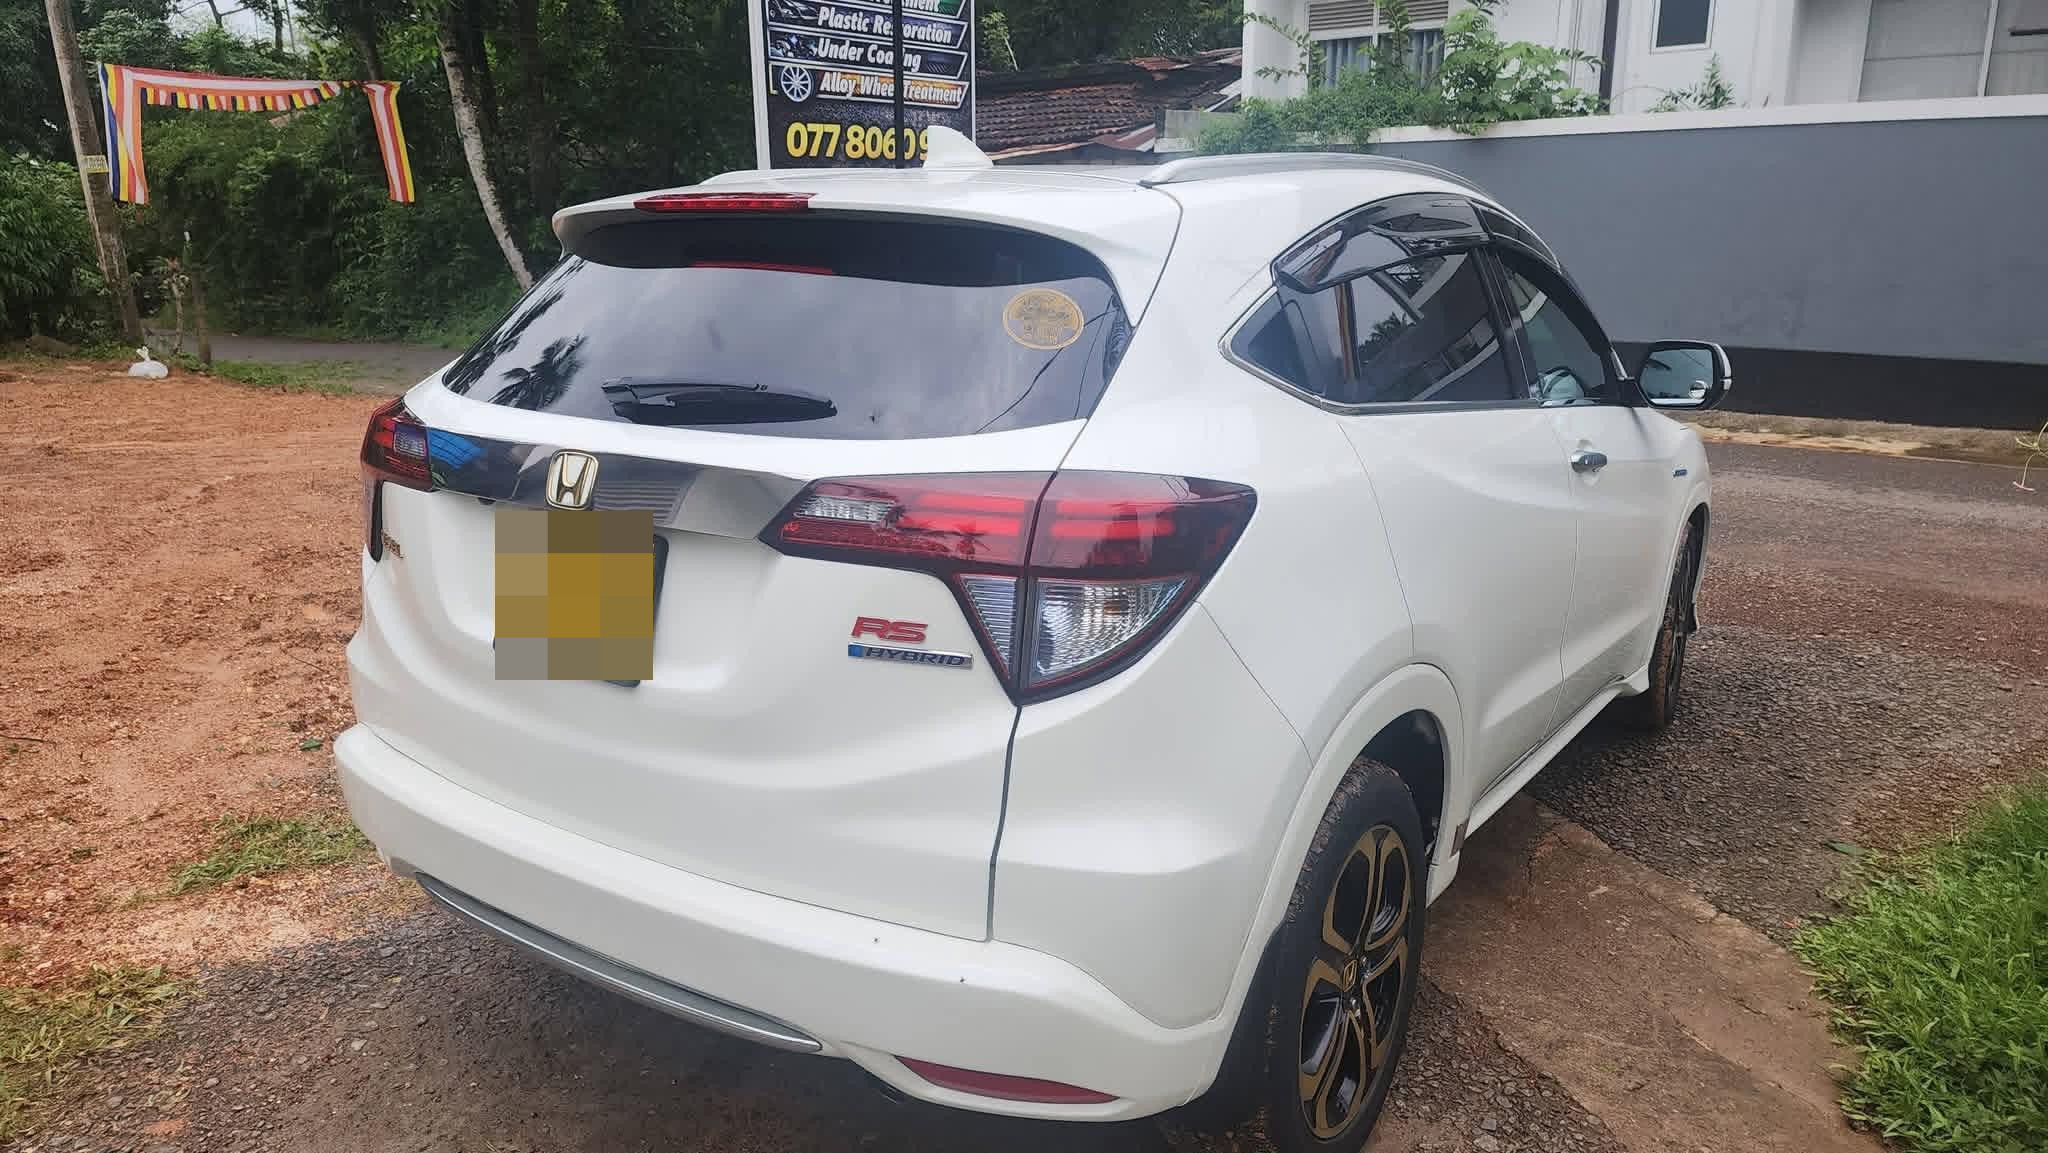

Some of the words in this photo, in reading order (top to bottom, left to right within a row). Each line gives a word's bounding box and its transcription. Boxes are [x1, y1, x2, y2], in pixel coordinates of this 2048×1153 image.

[818, 7, 870, 32] Plastic
[873, 15, 952, 43] Reoration
[818, 38, 864, 61] Under
[867, 44, 922, 72] Coang
[820, 72, 856, 98] Alloy
[860, 75, 896, 97] Whee
[903, 80, 963, 102] Treatment
[786, 122, 841, 158] 077
[851, 616, 928, 643] RS
[865, 647, 965, 666] HYBRID
